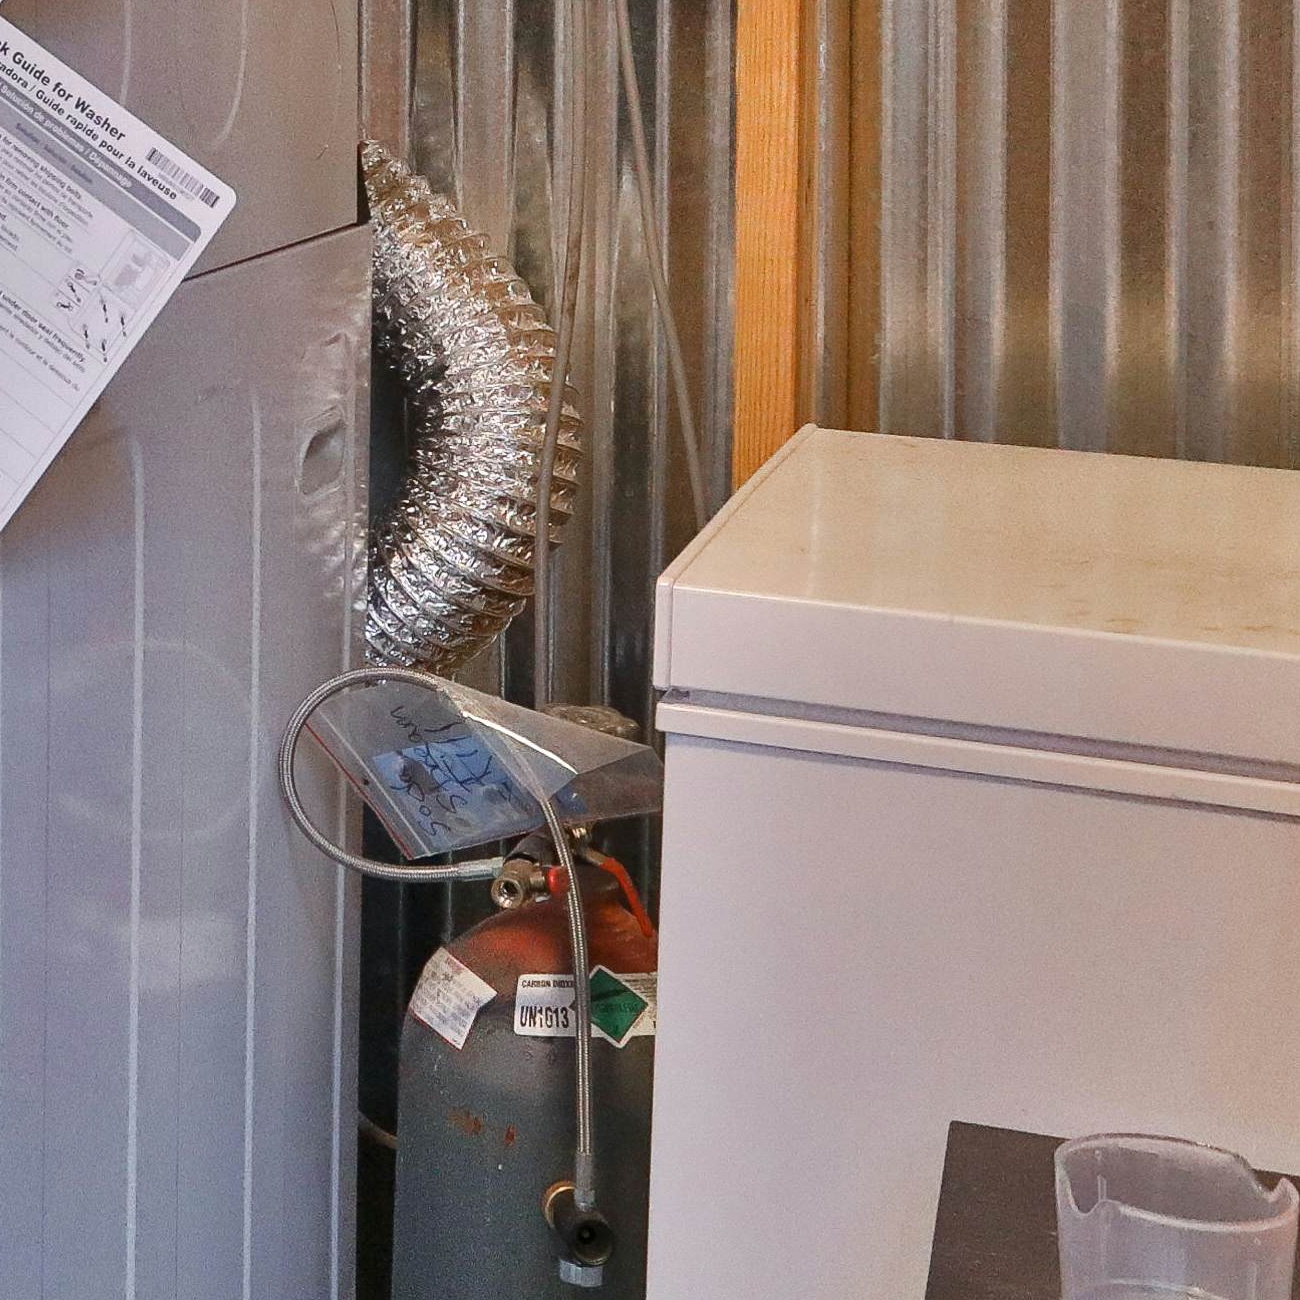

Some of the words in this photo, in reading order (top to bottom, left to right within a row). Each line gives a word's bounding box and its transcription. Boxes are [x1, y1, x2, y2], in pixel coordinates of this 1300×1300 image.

[12, 51, 50, 86] Guide
[51, 81, 73, 101] for
[74, 96, 125, 140] Washer
[35, 89, 64, 116] Guide
[65, 113, 99, 141] rapide
[98, 139, 124, 159] pour
[124, 156, 135, 169] la
[136, 165, 176, 200] laveuse
[522, 979, 551, 988] CARBON
[520, 1005, 569, 1028] UN1013
